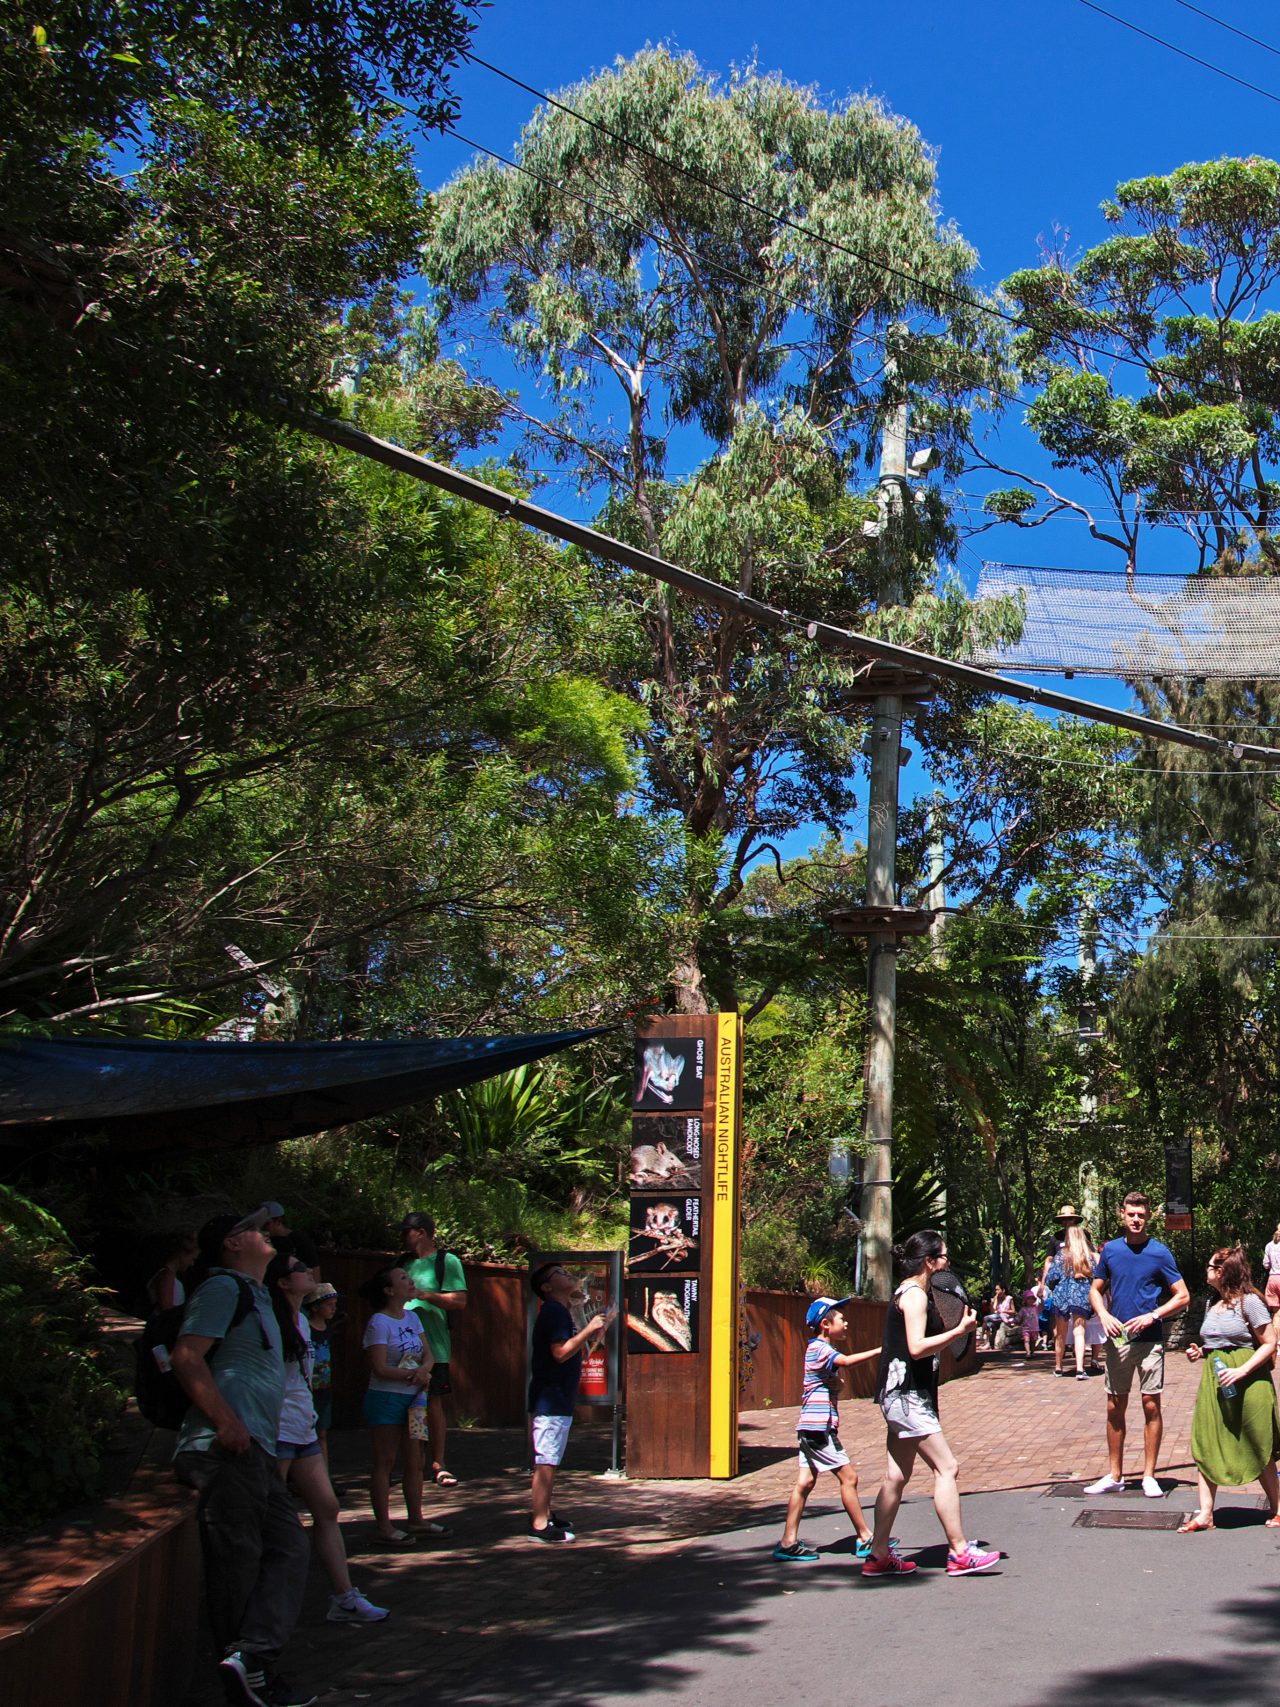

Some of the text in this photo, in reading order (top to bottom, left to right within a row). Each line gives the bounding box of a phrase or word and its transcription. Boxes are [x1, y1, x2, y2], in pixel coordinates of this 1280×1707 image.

[695, 1039, 704, 1080] GHOST BAT
[686, 1118, 694, 1155] BANDICOOT
[717, 1037, 732, 1201] AUSTRALIAN NIGHTLIFE
[685, 1198, 693, 1221] GLIDER
[692, 1198, 700, 1237] FEATHERTAIL
